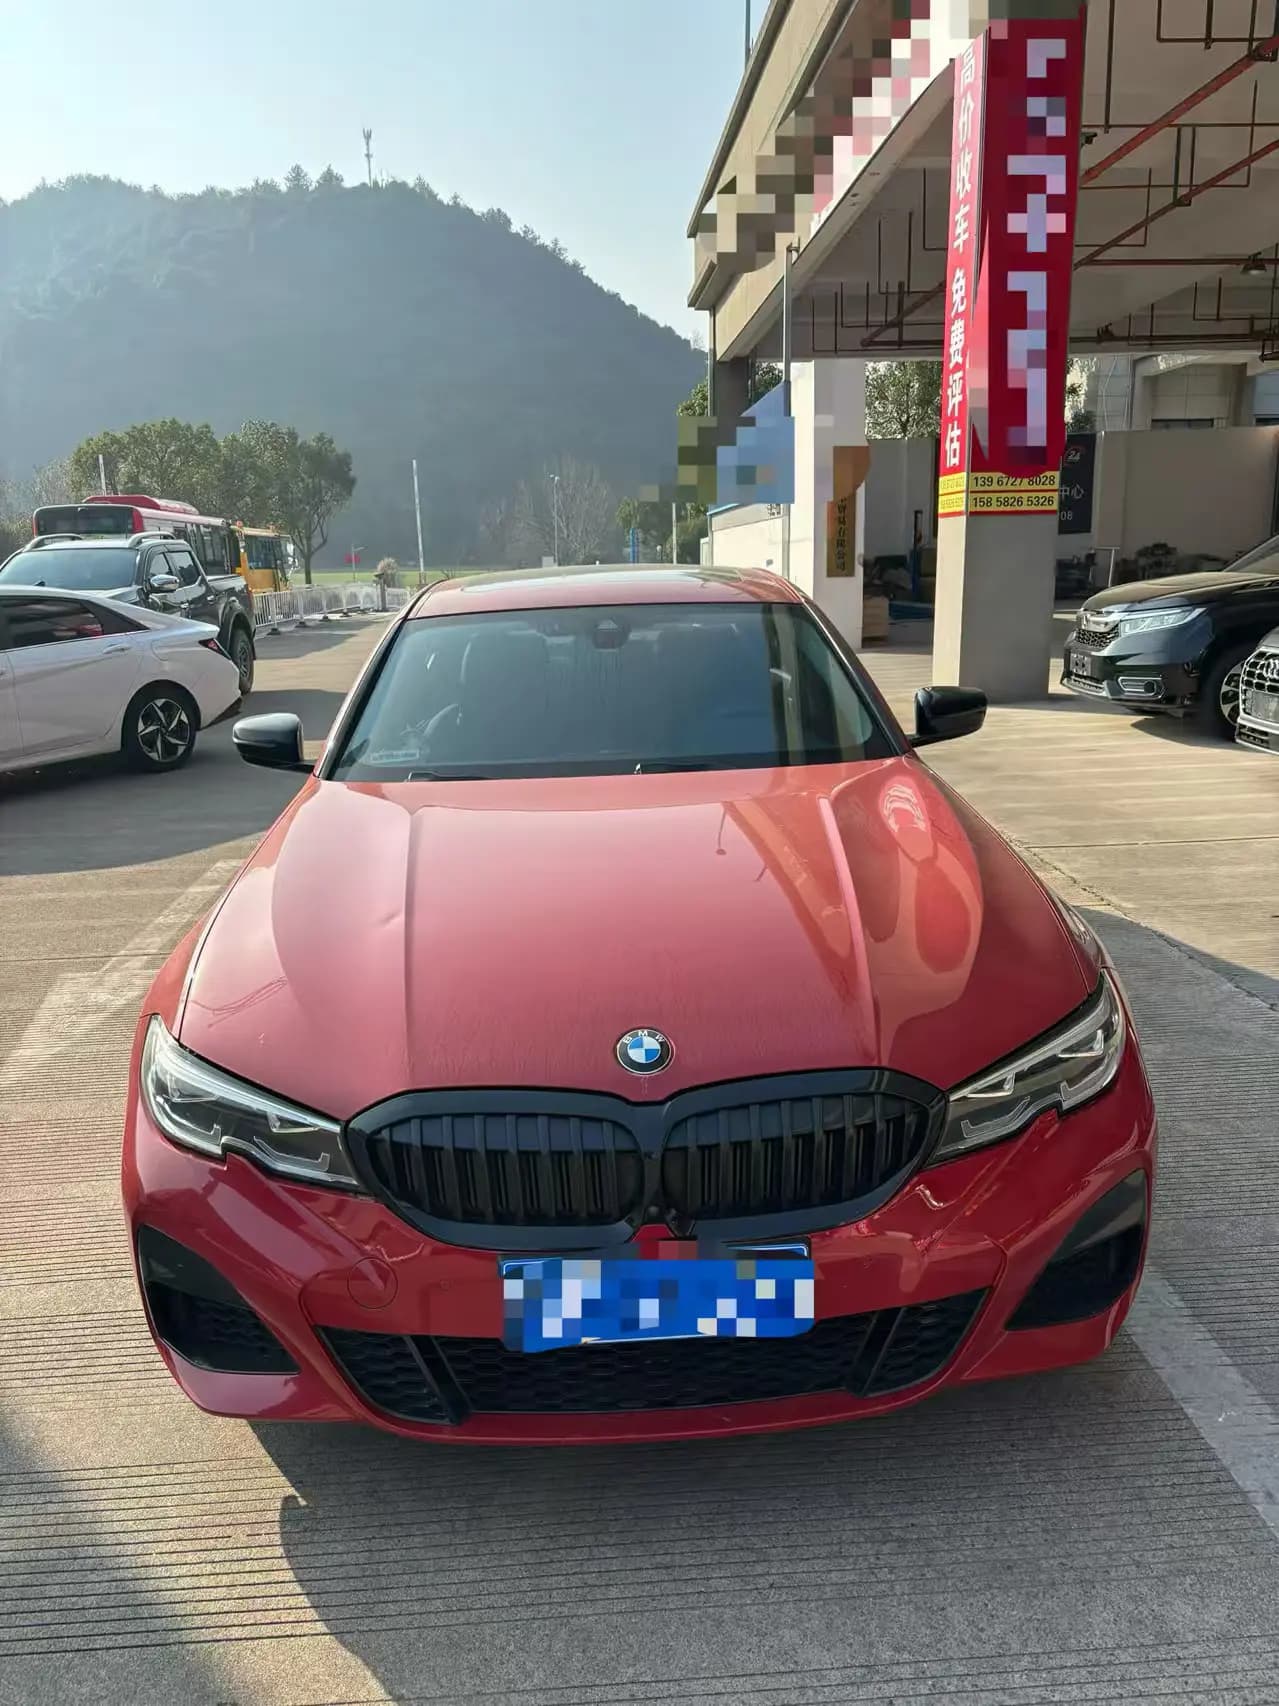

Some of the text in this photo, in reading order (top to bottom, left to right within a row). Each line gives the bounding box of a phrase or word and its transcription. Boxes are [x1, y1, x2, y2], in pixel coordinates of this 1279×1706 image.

[953, 46, 975, 255] 高价收车
[945, 267, 967, 468] 免费评估
[974, 476, 994, 487] 139
[997, 476, 1023, 487] 6727
[1028, 475, 1056, 486] 8028
[973, 497, 993, 508] 158
[996, 496, 1023, 507] 5826
[1027, 496, 1054, 507] 5326
[622, 1029, 666, 1044] BMW
